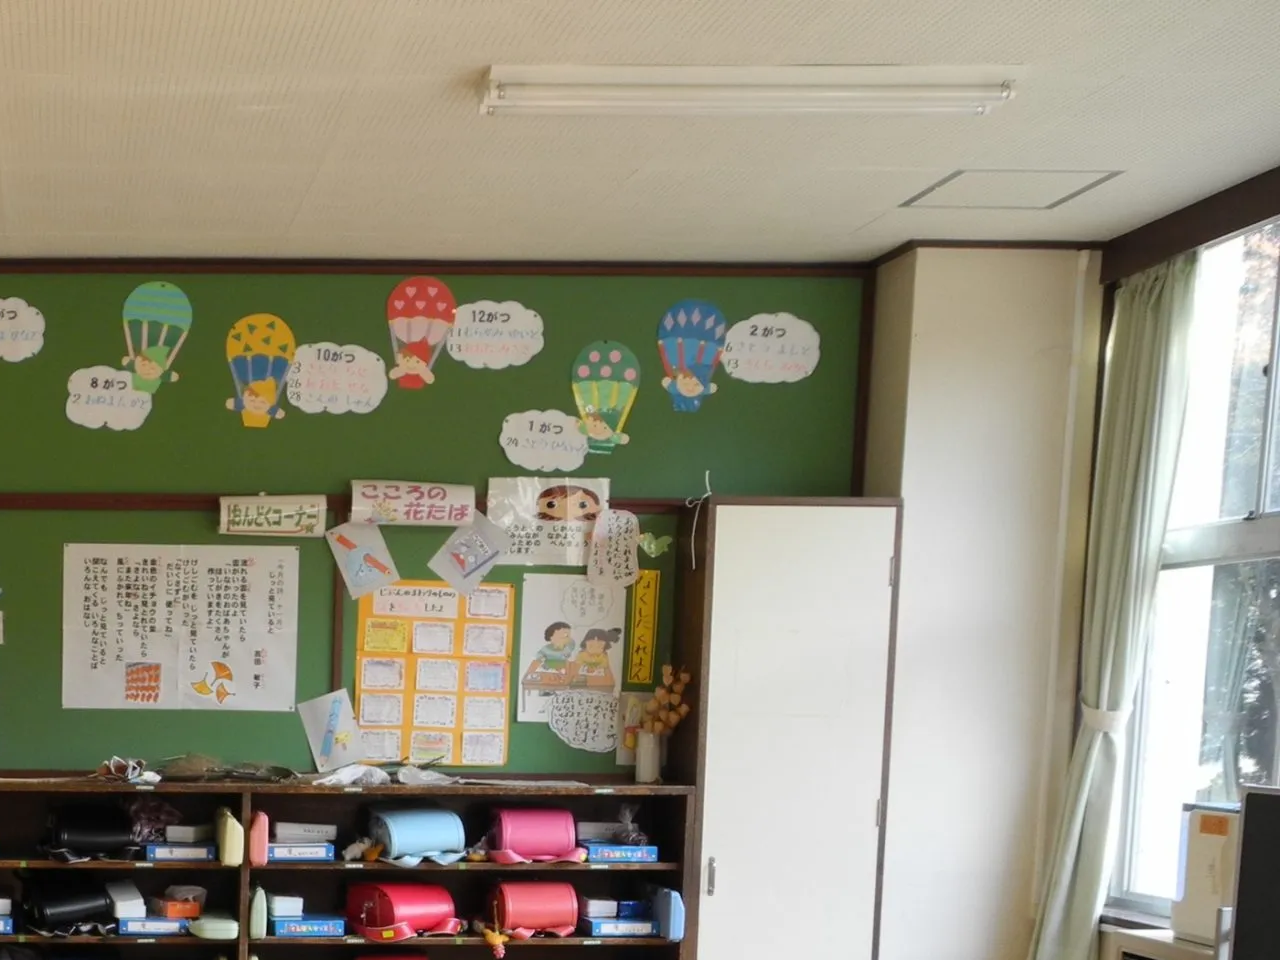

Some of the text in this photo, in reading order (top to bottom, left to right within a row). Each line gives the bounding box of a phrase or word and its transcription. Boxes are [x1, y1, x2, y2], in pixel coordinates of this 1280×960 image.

[361, 483, 448, 502] こころの
[230, 503, 318, 528] おんどくコーナー
[403, 501, 471, 521] 花たば
